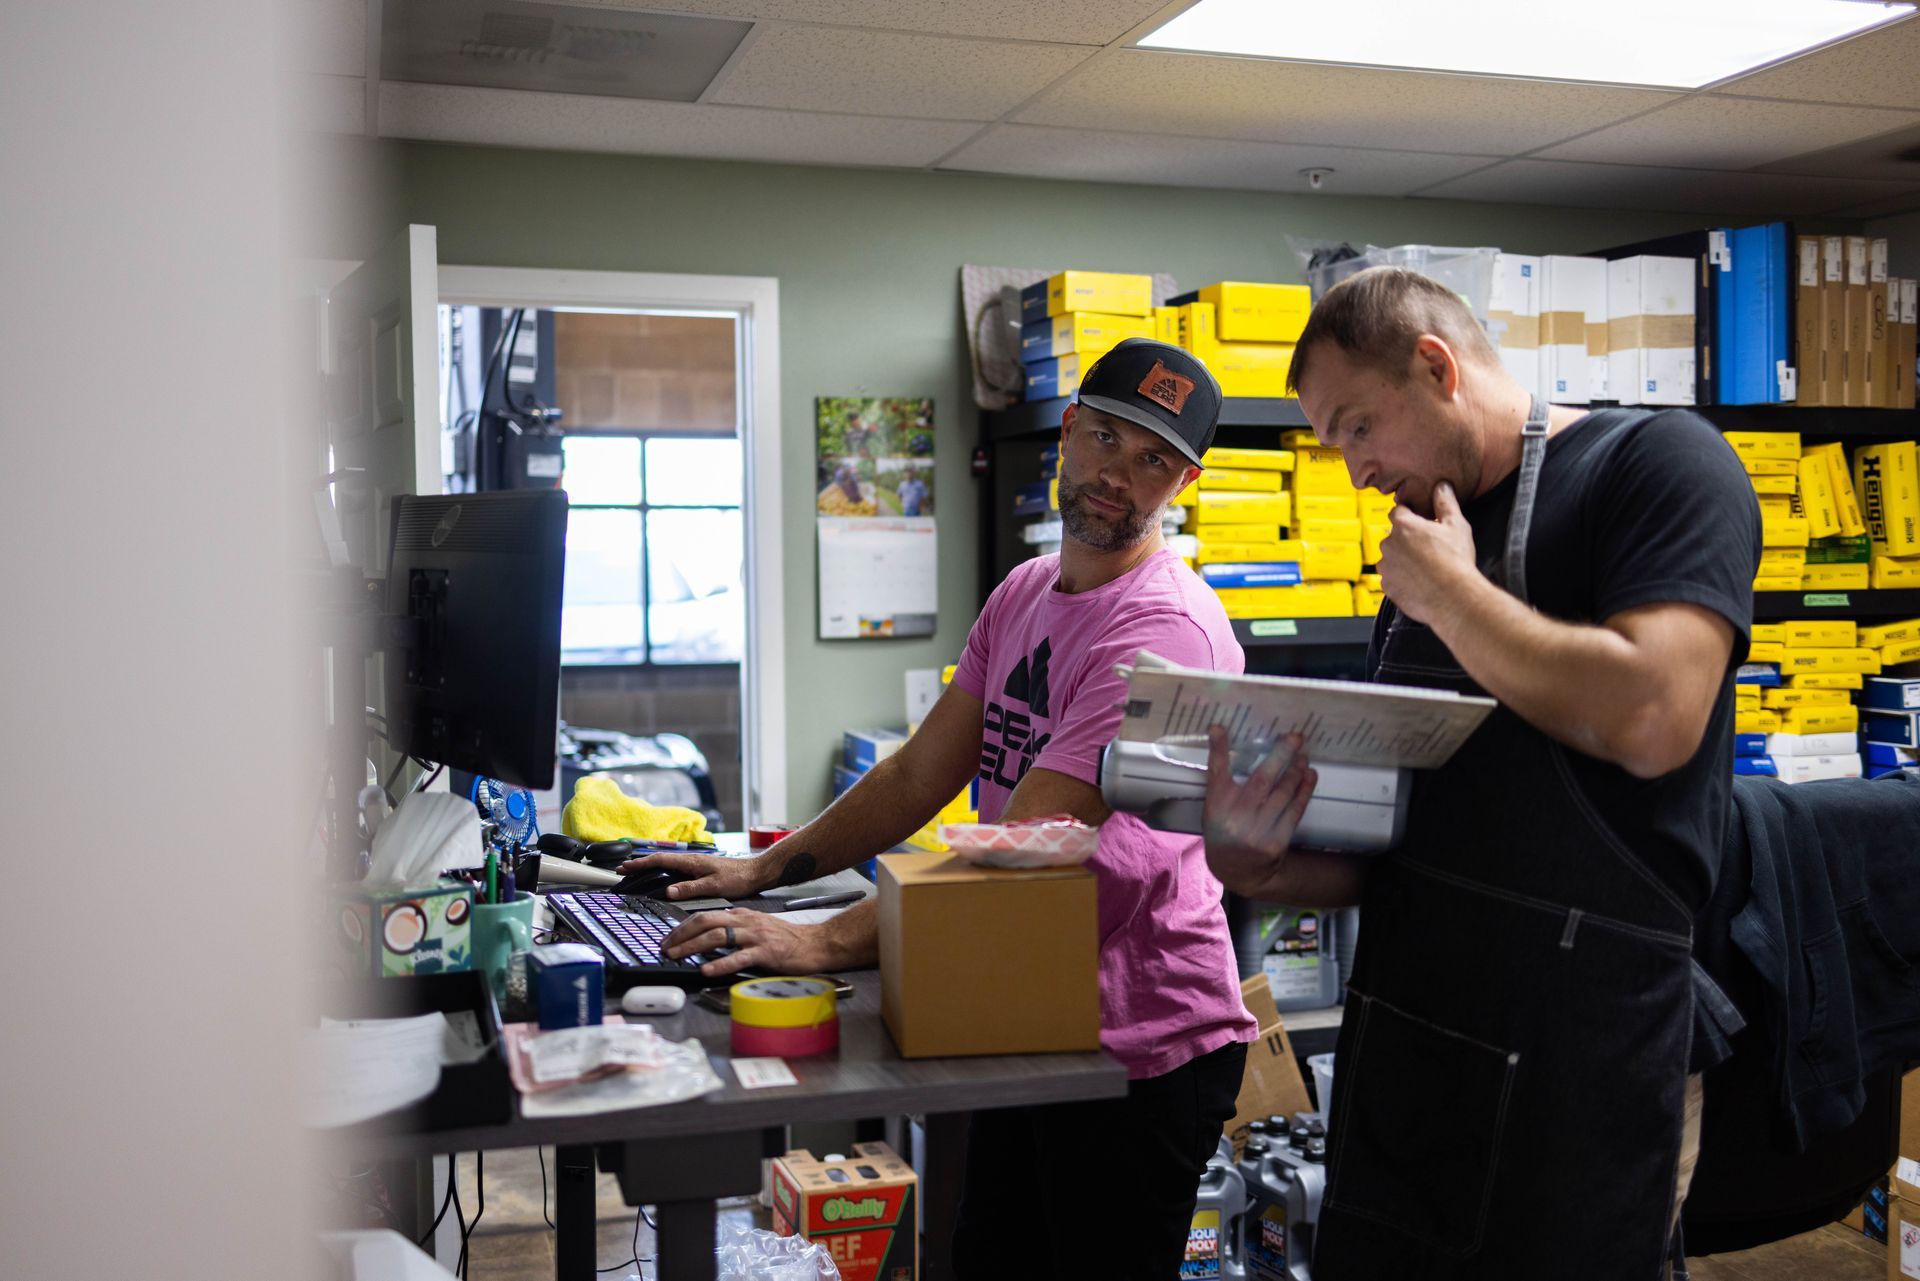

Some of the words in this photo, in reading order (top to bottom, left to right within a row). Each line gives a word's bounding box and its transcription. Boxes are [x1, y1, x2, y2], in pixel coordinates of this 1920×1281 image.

[1150, 389, 1176, 405] EURO
[1152, 383, 1177, 398] PEAK
[822, 1197, 887, 1222] O'Reilly
